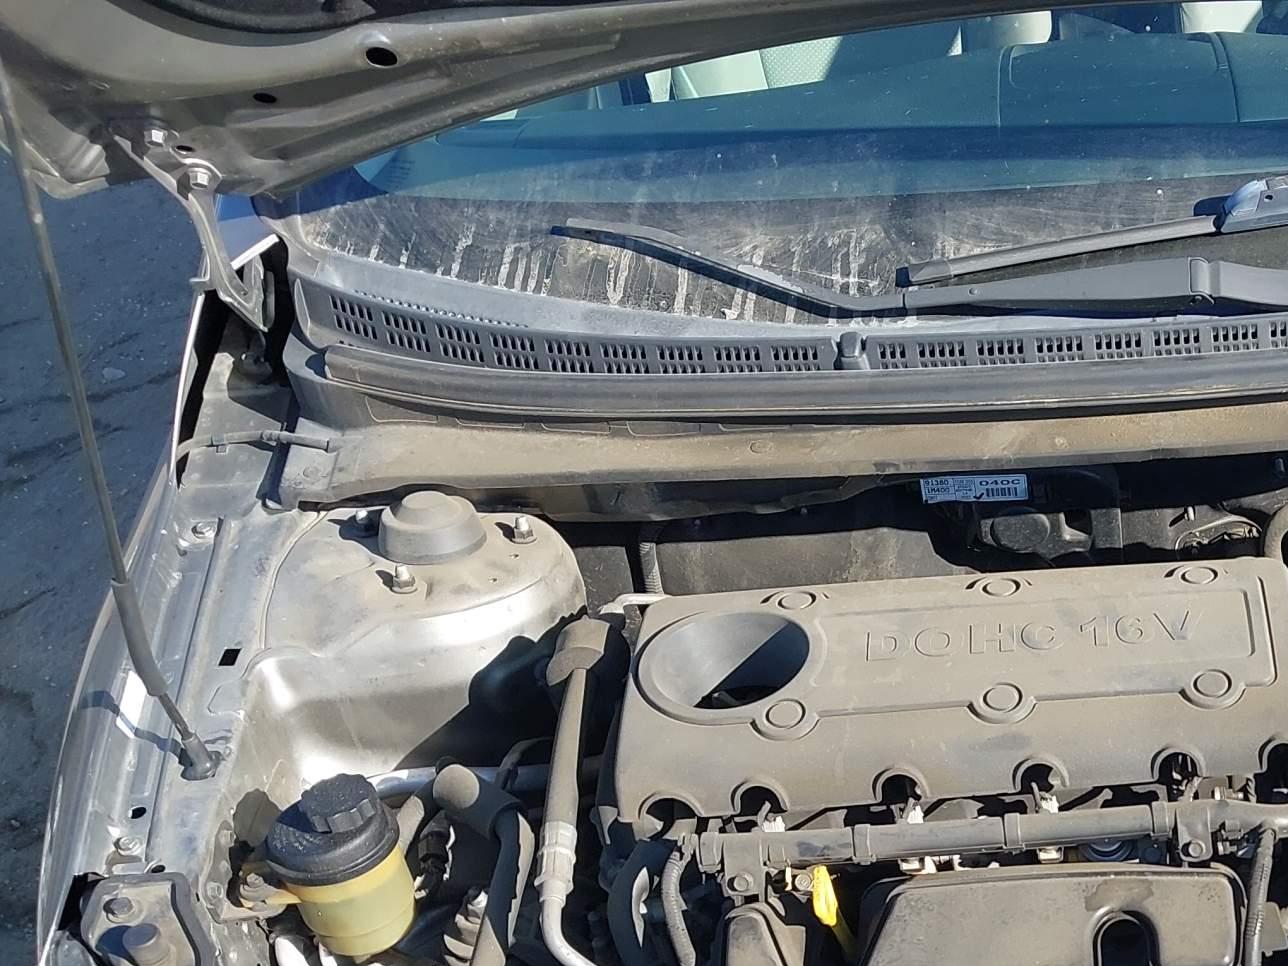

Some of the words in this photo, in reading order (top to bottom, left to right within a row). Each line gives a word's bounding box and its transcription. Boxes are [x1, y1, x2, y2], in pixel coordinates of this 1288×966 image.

[979, 479, 1021, 487] 040C
[865, 621, 1066, 663] DOHC
[1079, 608, 1199, 649] 16V
